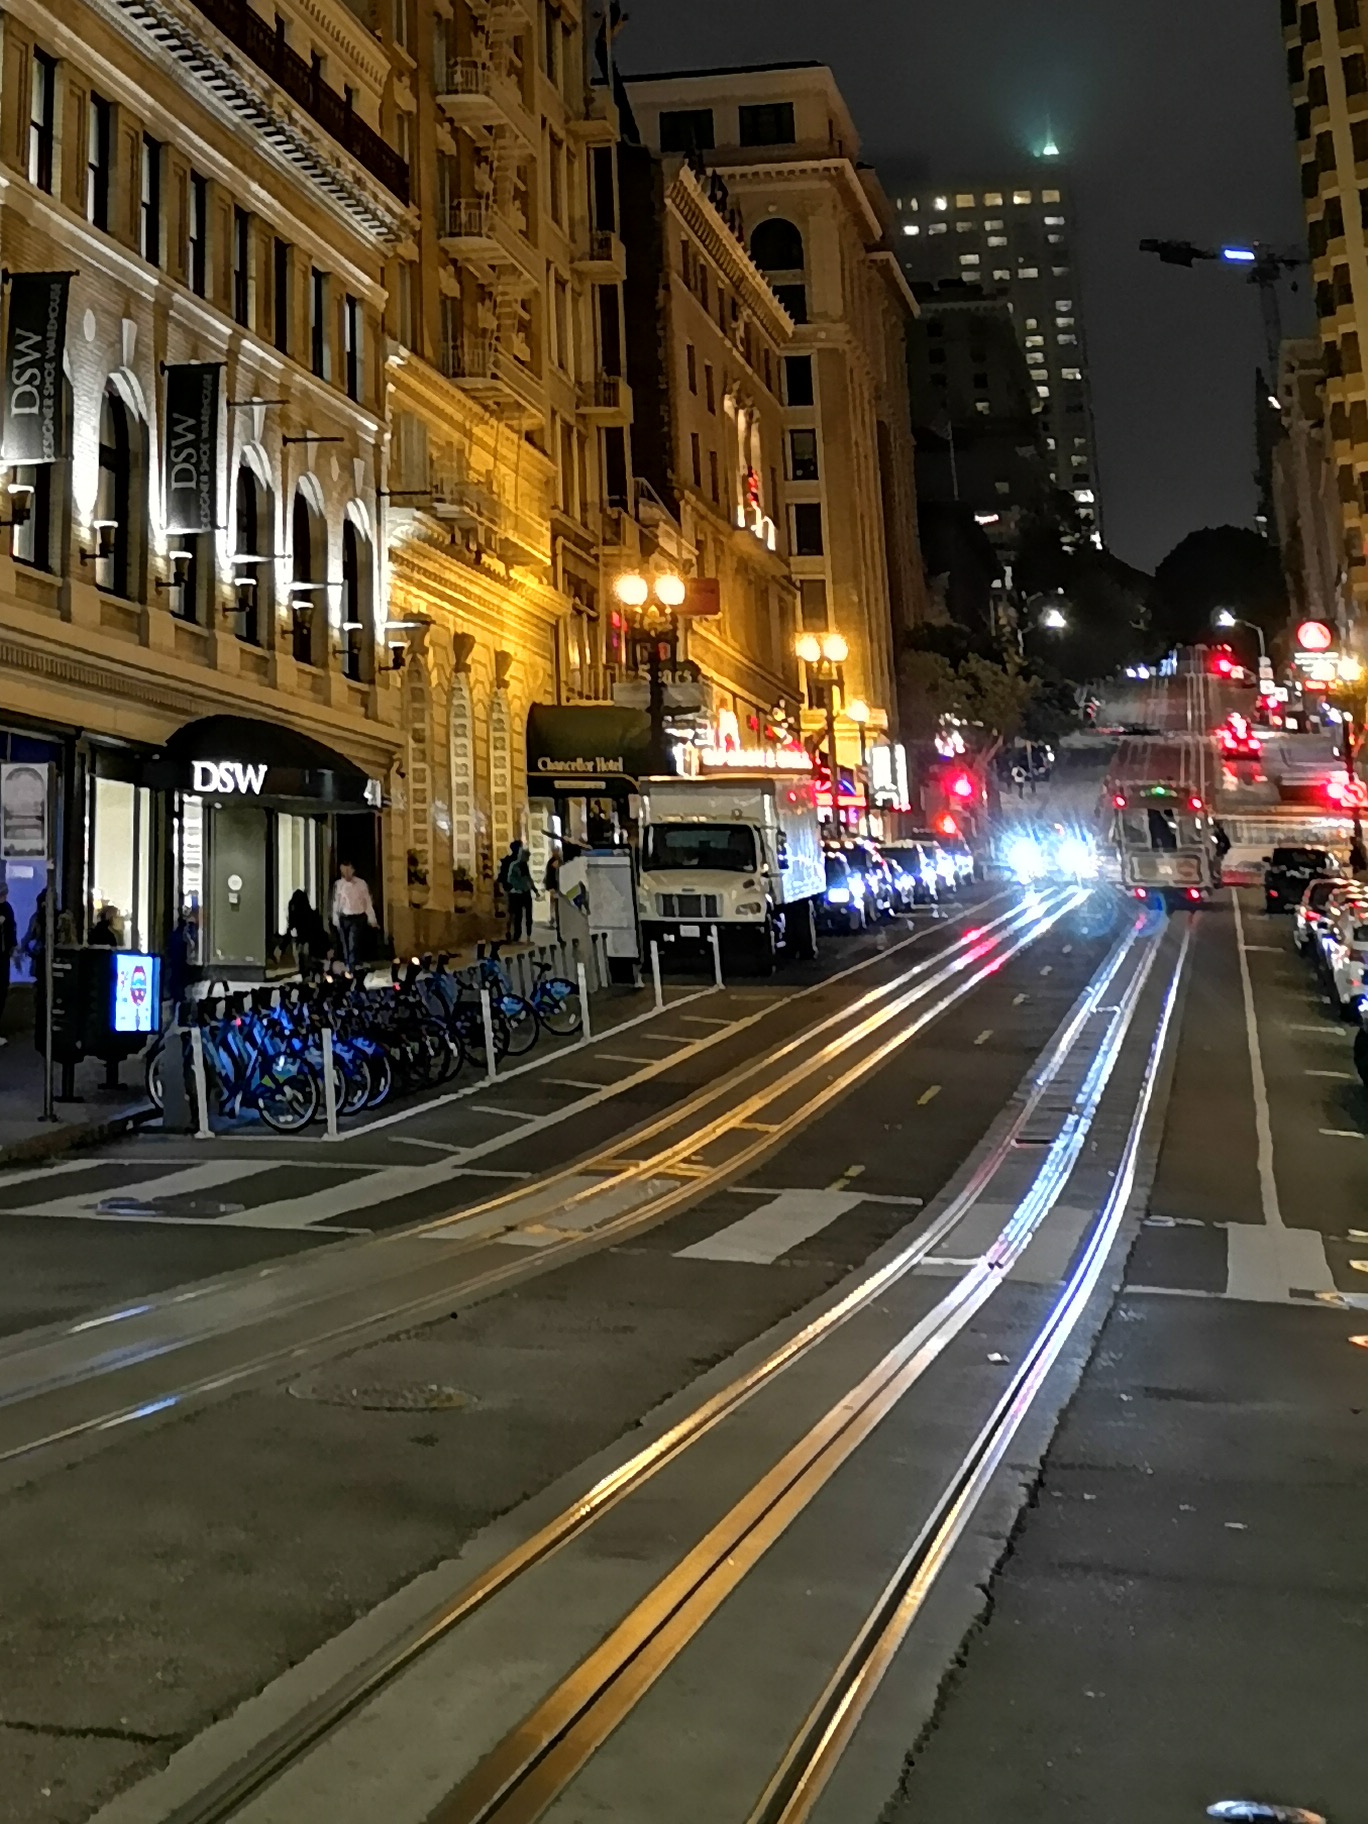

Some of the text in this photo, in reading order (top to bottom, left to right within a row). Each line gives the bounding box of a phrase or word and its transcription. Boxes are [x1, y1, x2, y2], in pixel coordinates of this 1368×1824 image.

[11, 327, 43, 418] DSW
[43, 362, 56, 396] SHOE
[170, 412, 198, 490] DSW
[192, 760, 268, 795] DSW
[537, 756, 623, 772] Chancellor Hotel
